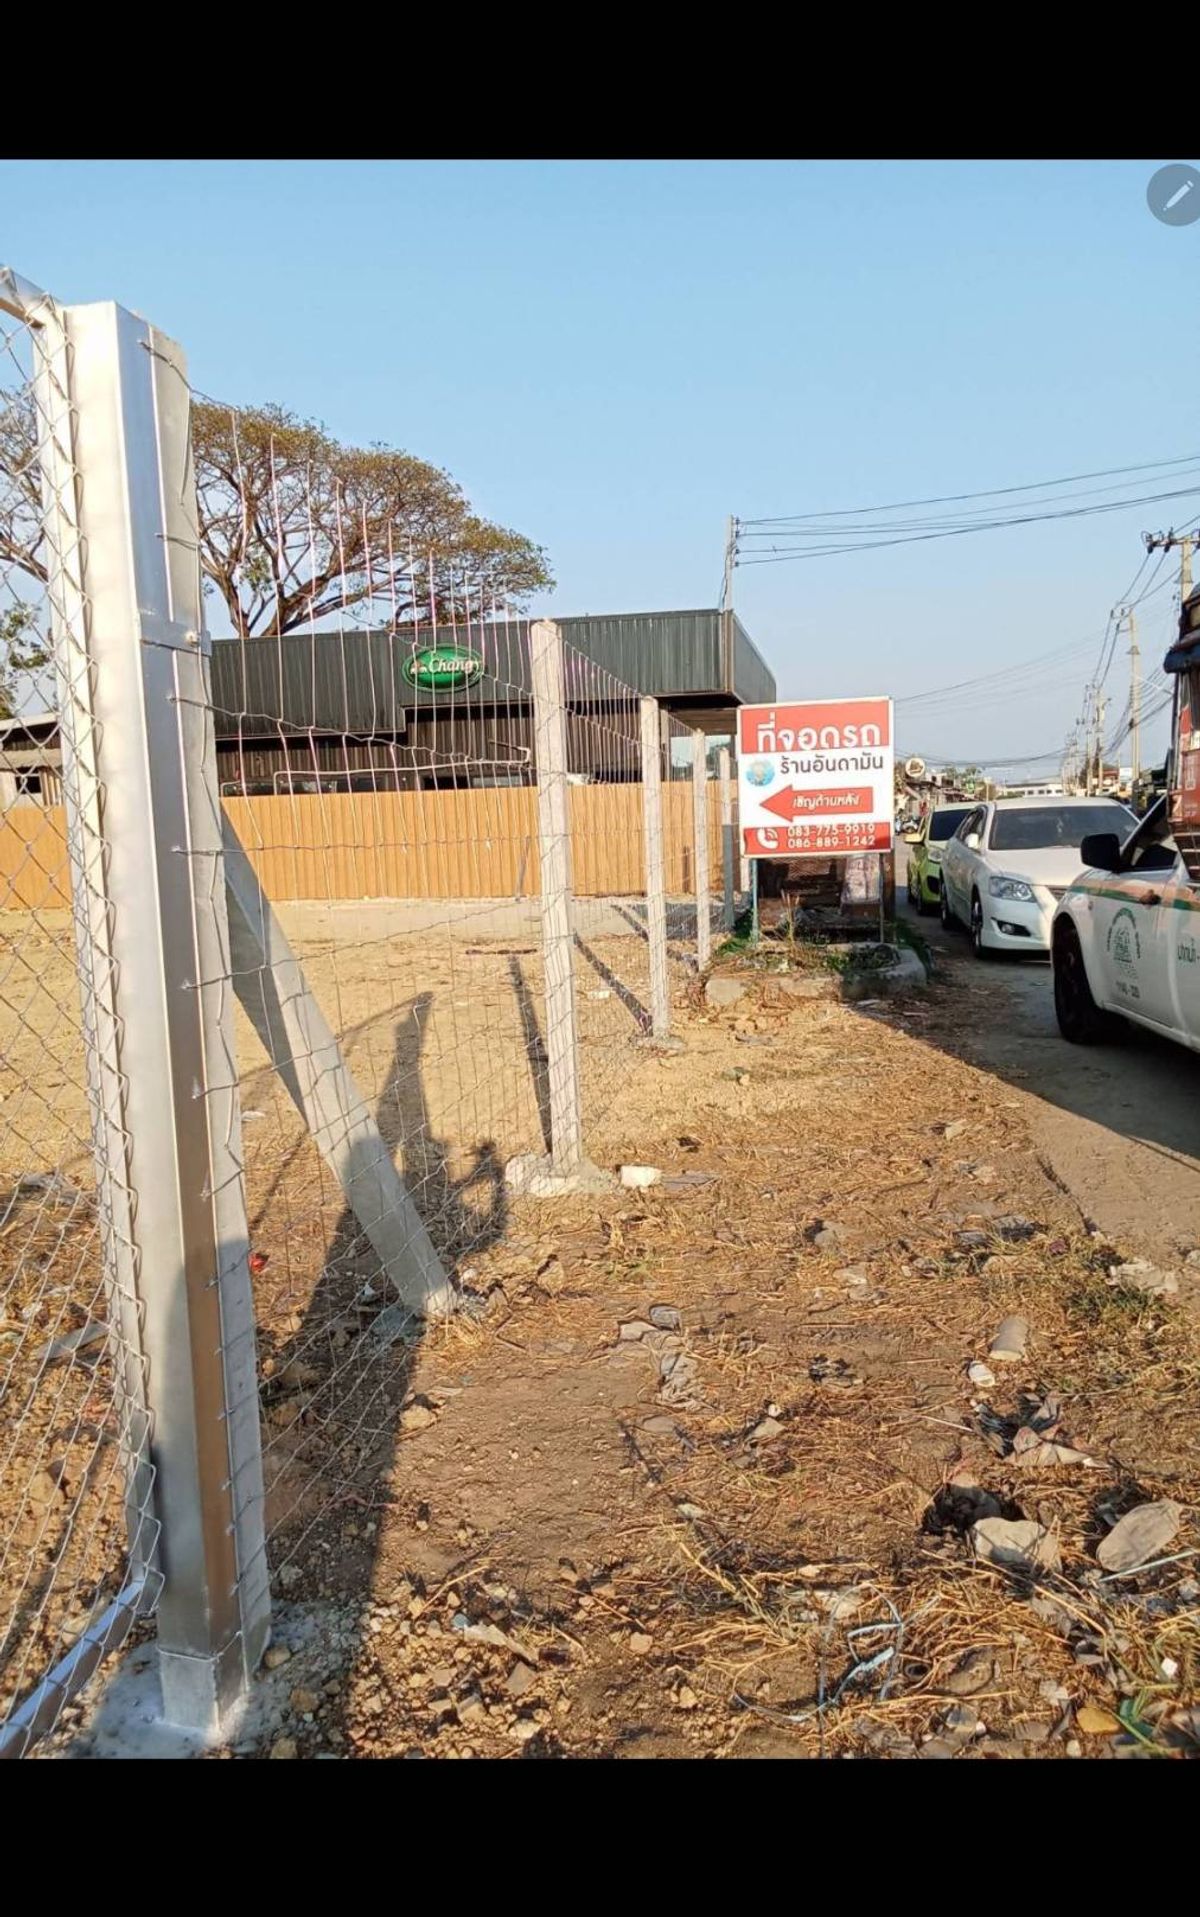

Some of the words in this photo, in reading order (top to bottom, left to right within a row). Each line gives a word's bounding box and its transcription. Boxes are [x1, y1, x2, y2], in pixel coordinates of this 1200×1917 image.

[428, 656, 474, 674] Chang
[757, 711, 881, 752] ที่จอดรถ
[780, 752, 884, 774] ร้านอันดามัน
[793, 793, 859, 811] เชิญด้านหลัง
[787, 835, 875, 848] 086-889-1242
